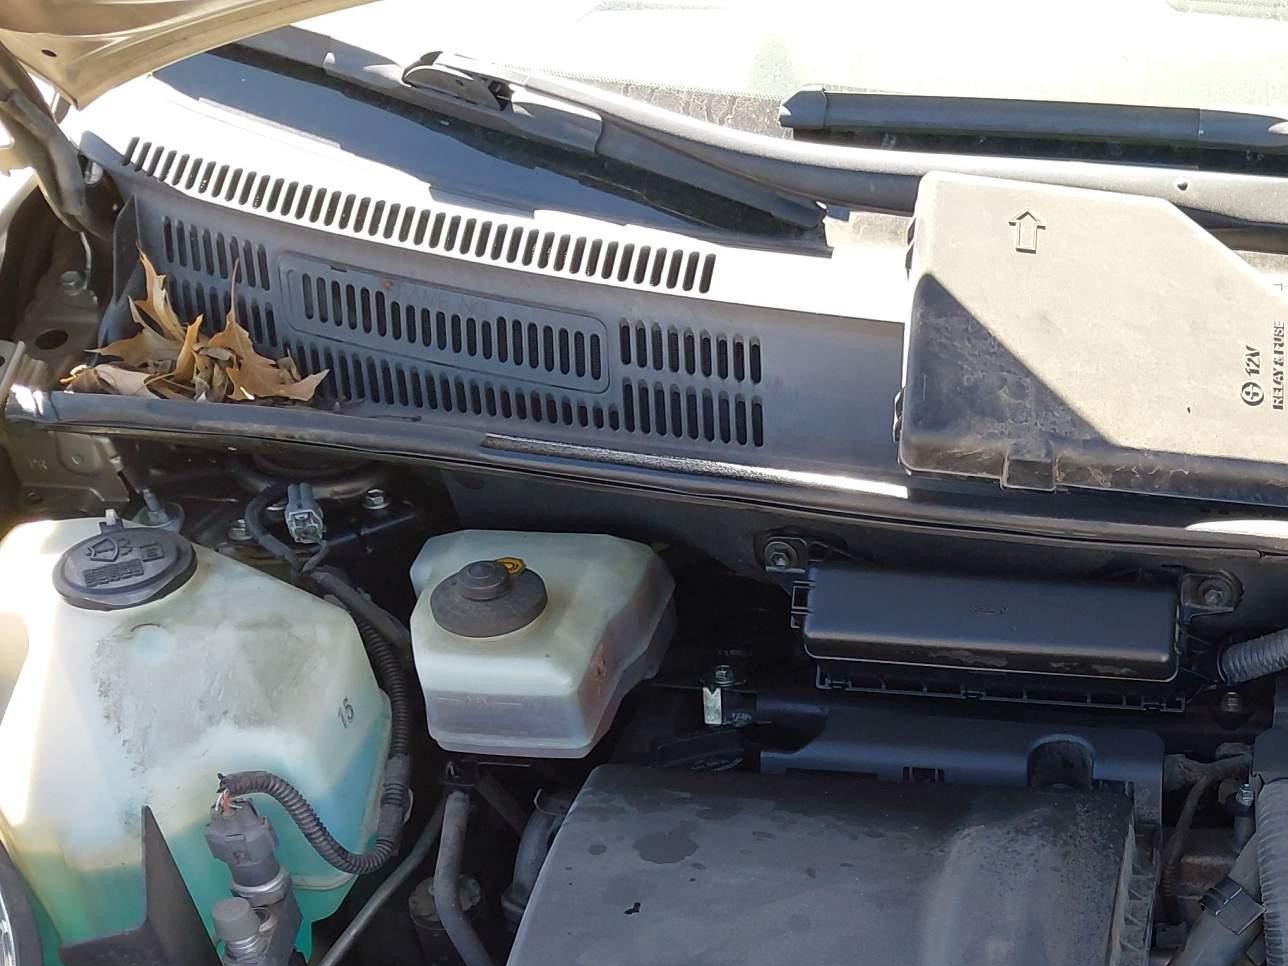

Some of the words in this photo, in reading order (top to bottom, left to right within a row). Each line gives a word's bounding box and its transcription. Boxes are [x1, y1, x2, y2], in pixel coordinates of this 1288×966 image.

[1272, 319, 1285, 355] FUSE
[1244, 344, 1261, 377] 12V
[1272, 367, 1284, 410] RELAY
